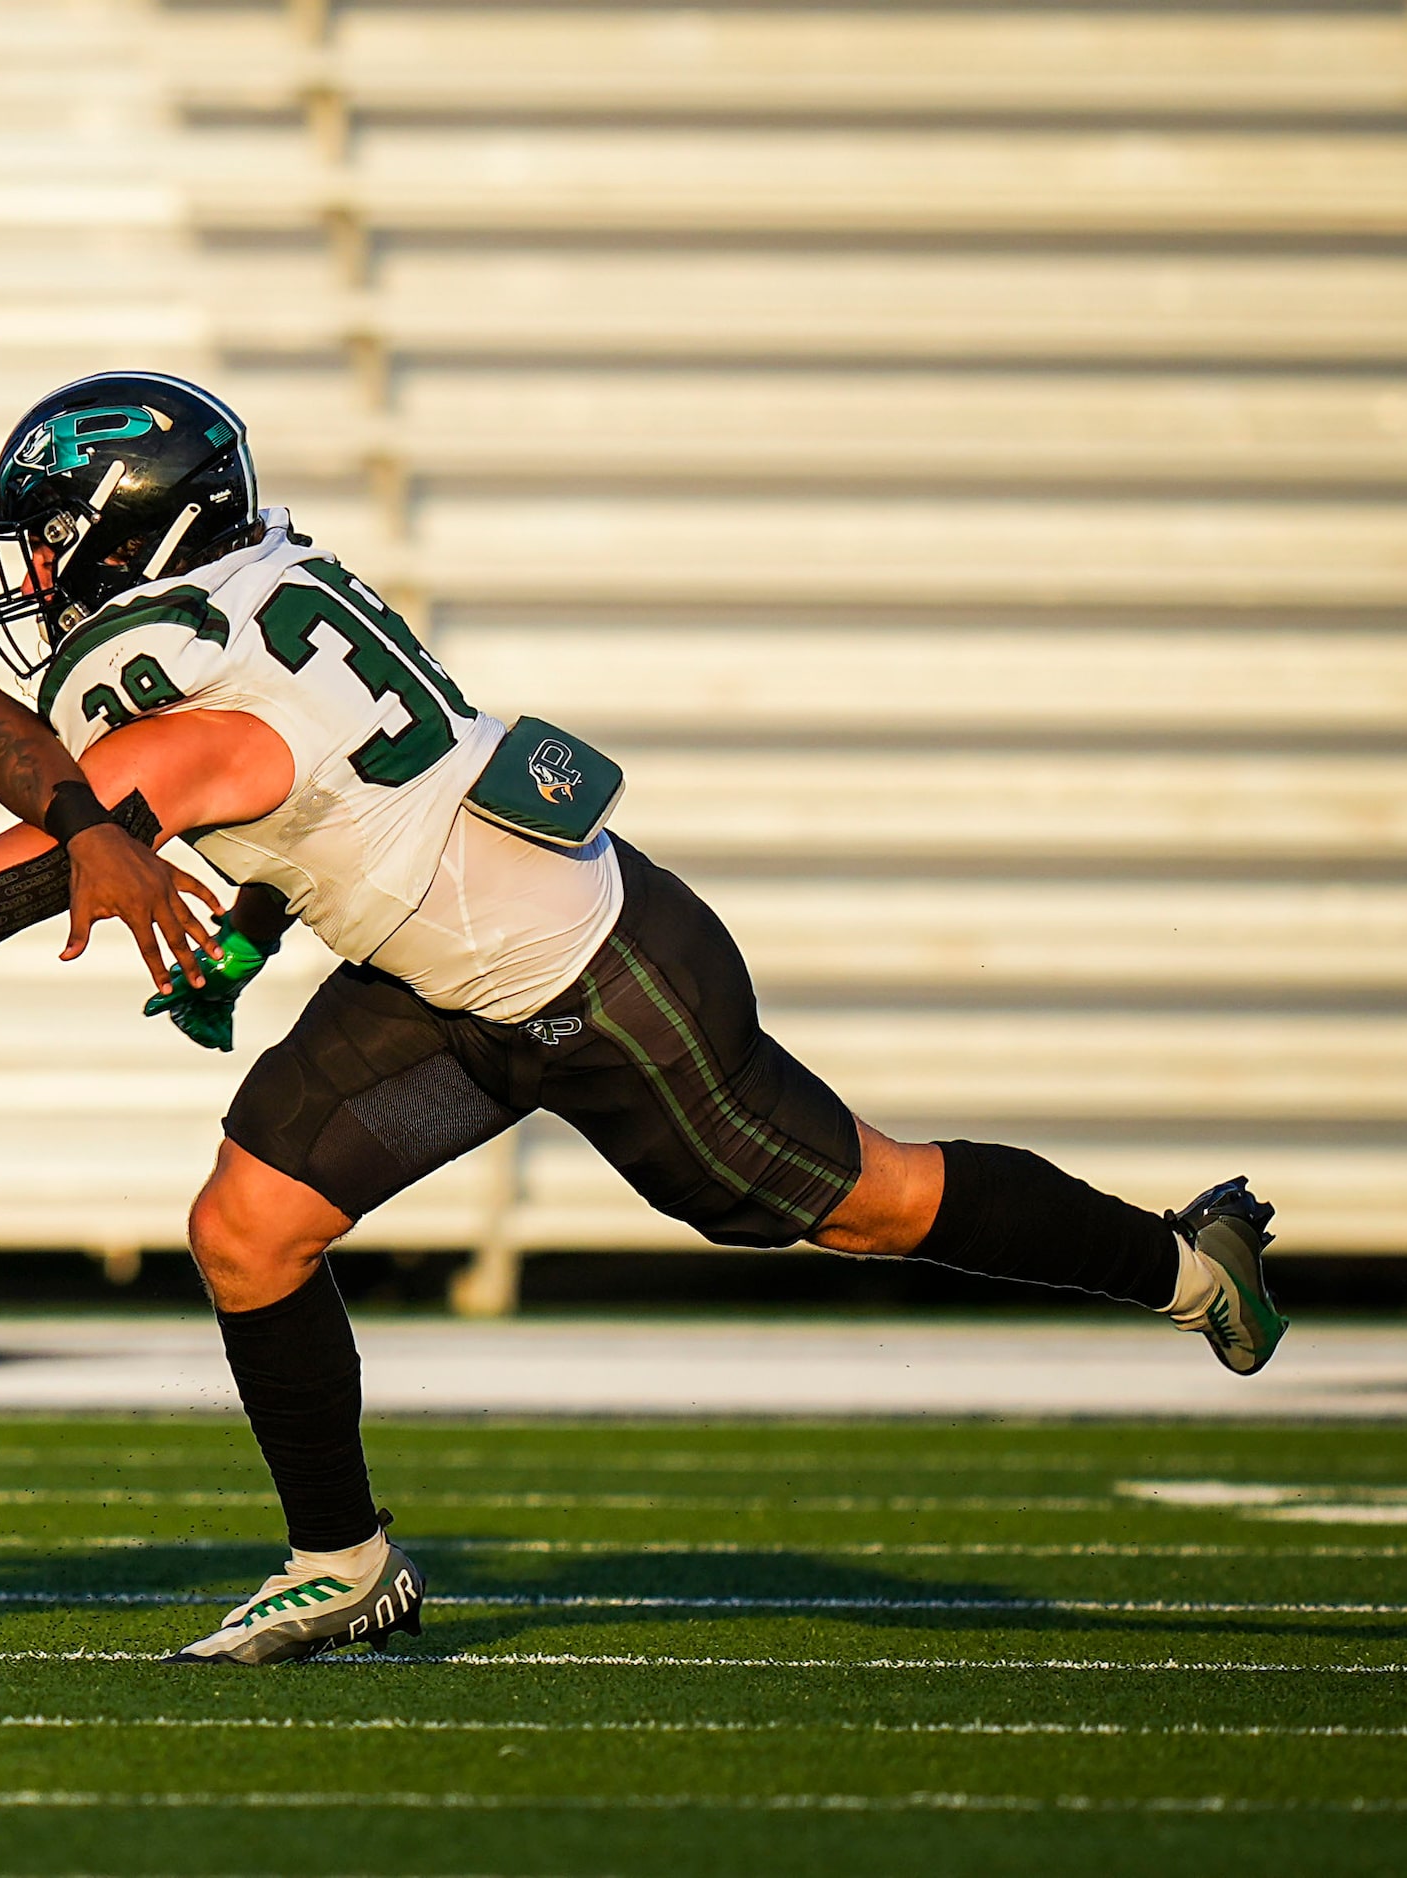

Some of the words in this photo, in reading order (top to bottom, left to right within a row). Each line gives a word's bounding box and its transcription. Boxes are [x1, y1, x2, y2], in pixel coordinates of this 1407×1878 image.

[44, 406, 153, 476] P
[81, 652, 188, 728] 38
[529, 738, 581, 786] P
[540, 1016, 582, 1045] P
